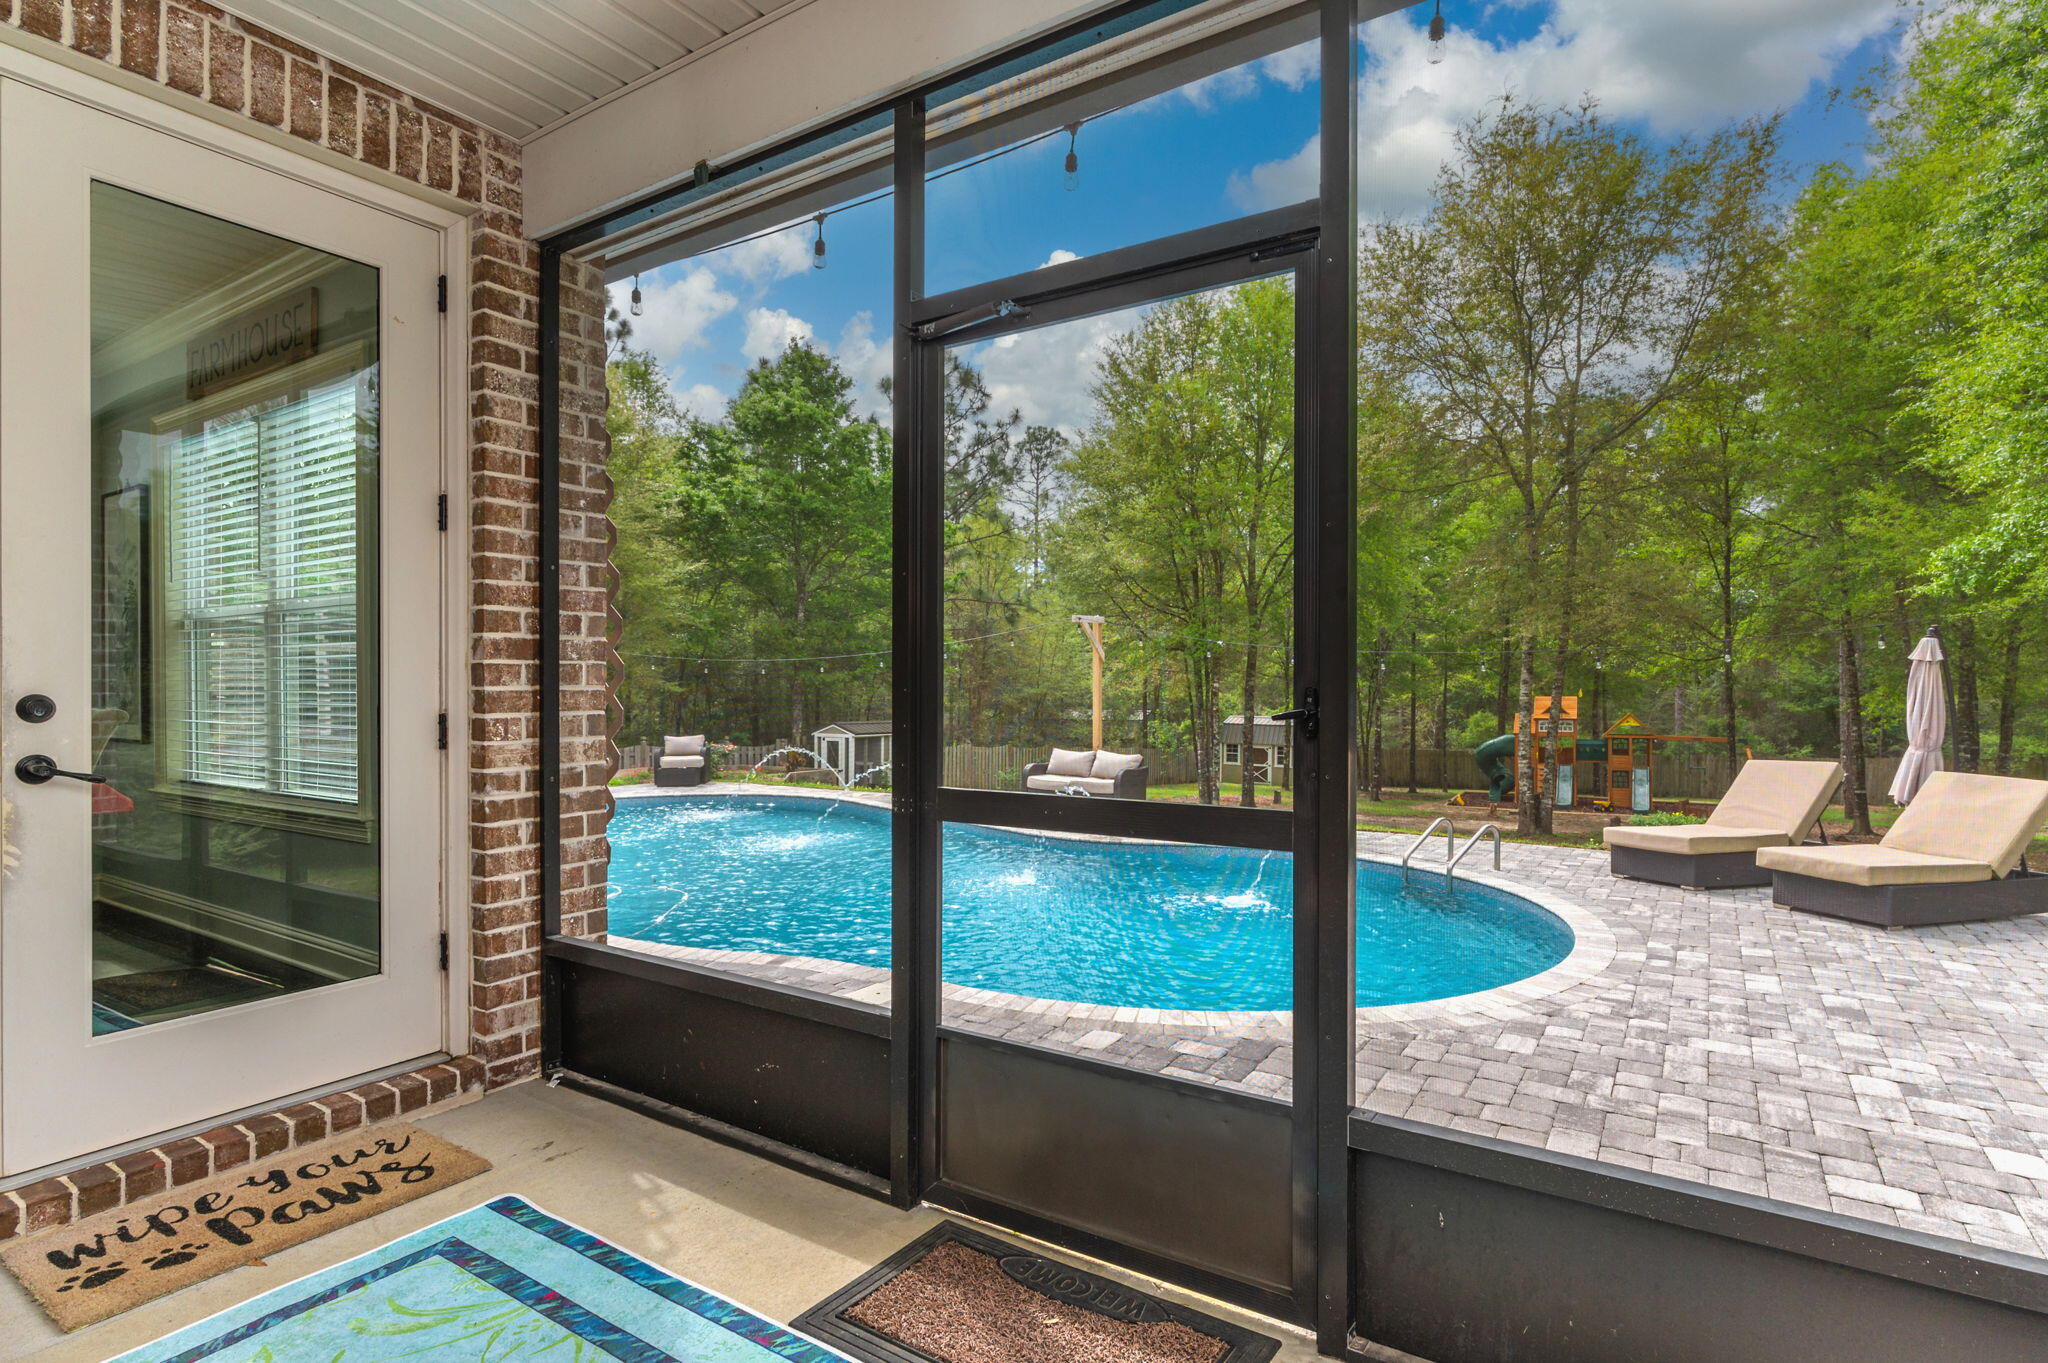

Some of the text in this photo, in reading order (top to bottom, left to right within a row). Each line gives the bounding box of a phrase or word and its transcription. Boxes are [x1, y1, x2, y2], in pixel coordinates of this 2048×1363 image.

[190, 303, 304, 388] FARMHOUSE
[46, 1135, 412, 1270] wipe your
[206, 1151, 435, 1246] paws
[1016, 1259, 1149, 1320] WELCOME
